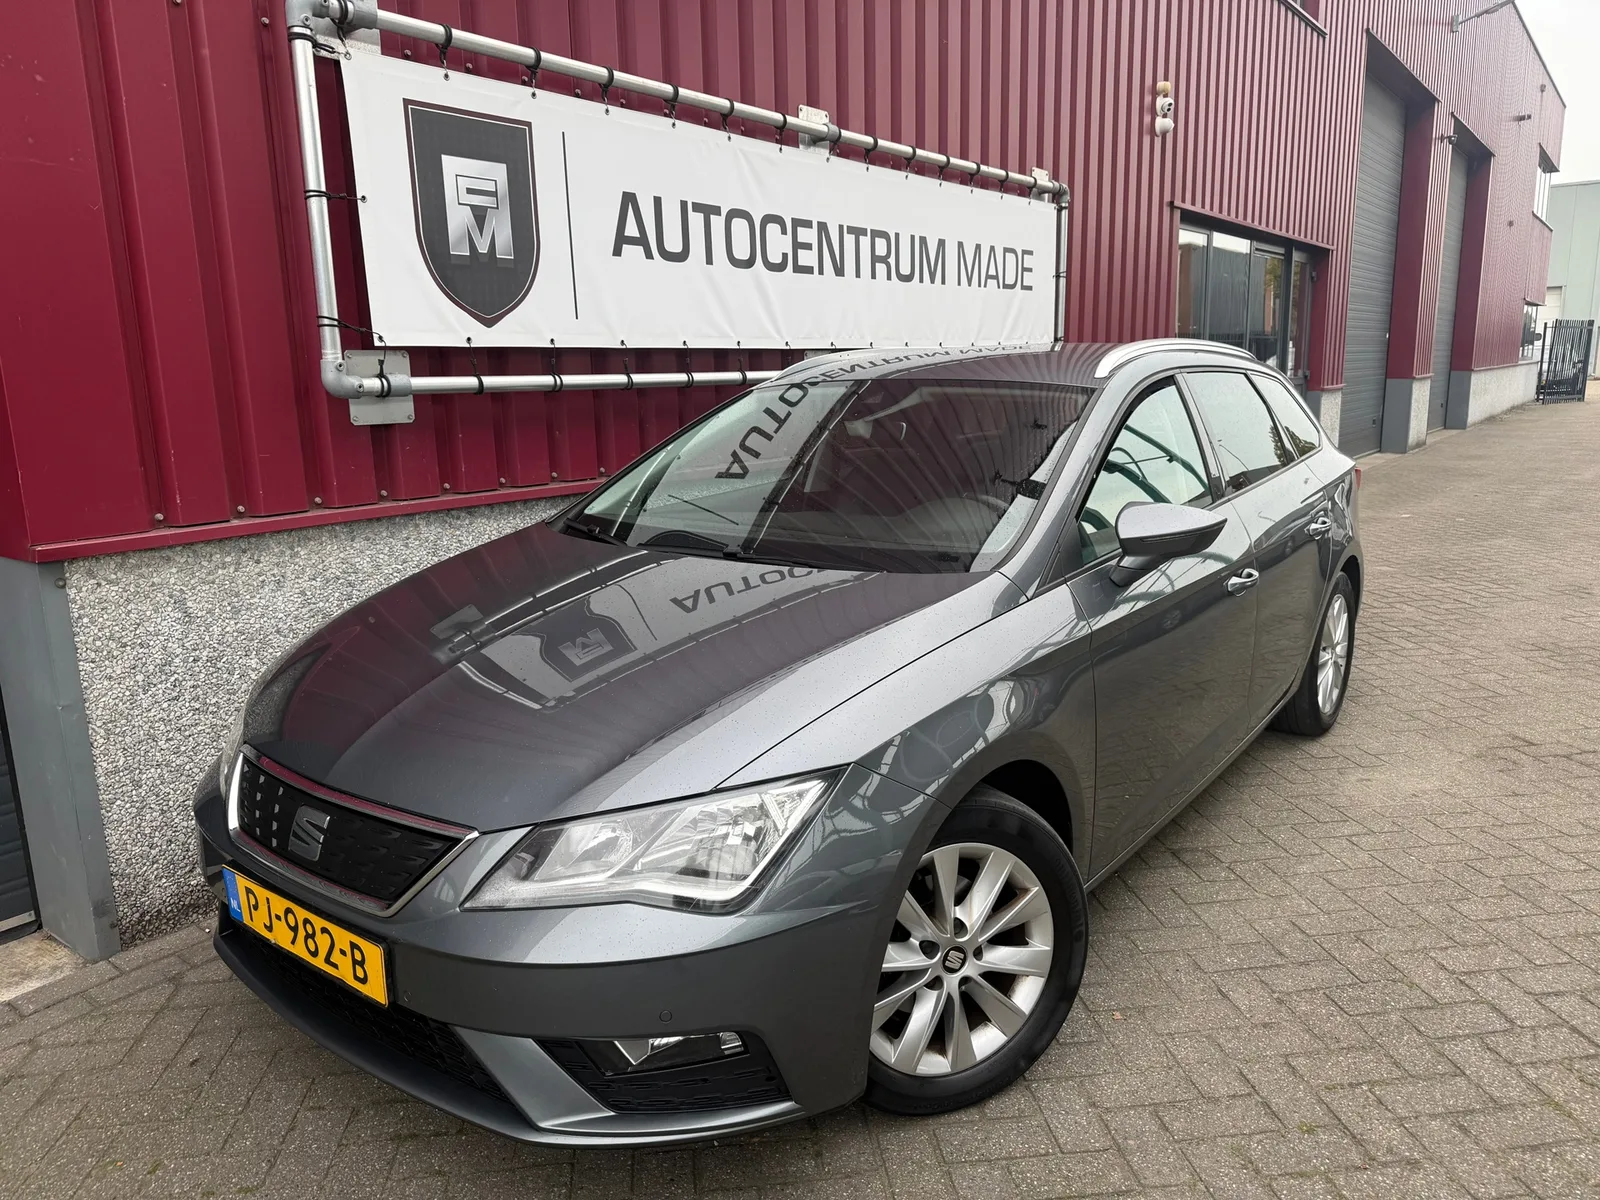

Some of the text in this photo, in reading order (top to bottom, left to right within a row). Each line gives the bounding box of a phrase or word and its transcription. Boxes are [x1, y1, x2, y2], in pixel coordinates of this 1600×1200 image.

[612, 191, 1034, 291] AUTOCENTRUM MADE
[230, 897, 242, 913] NL
[244, 885, 369, 985] PJ-982-B
